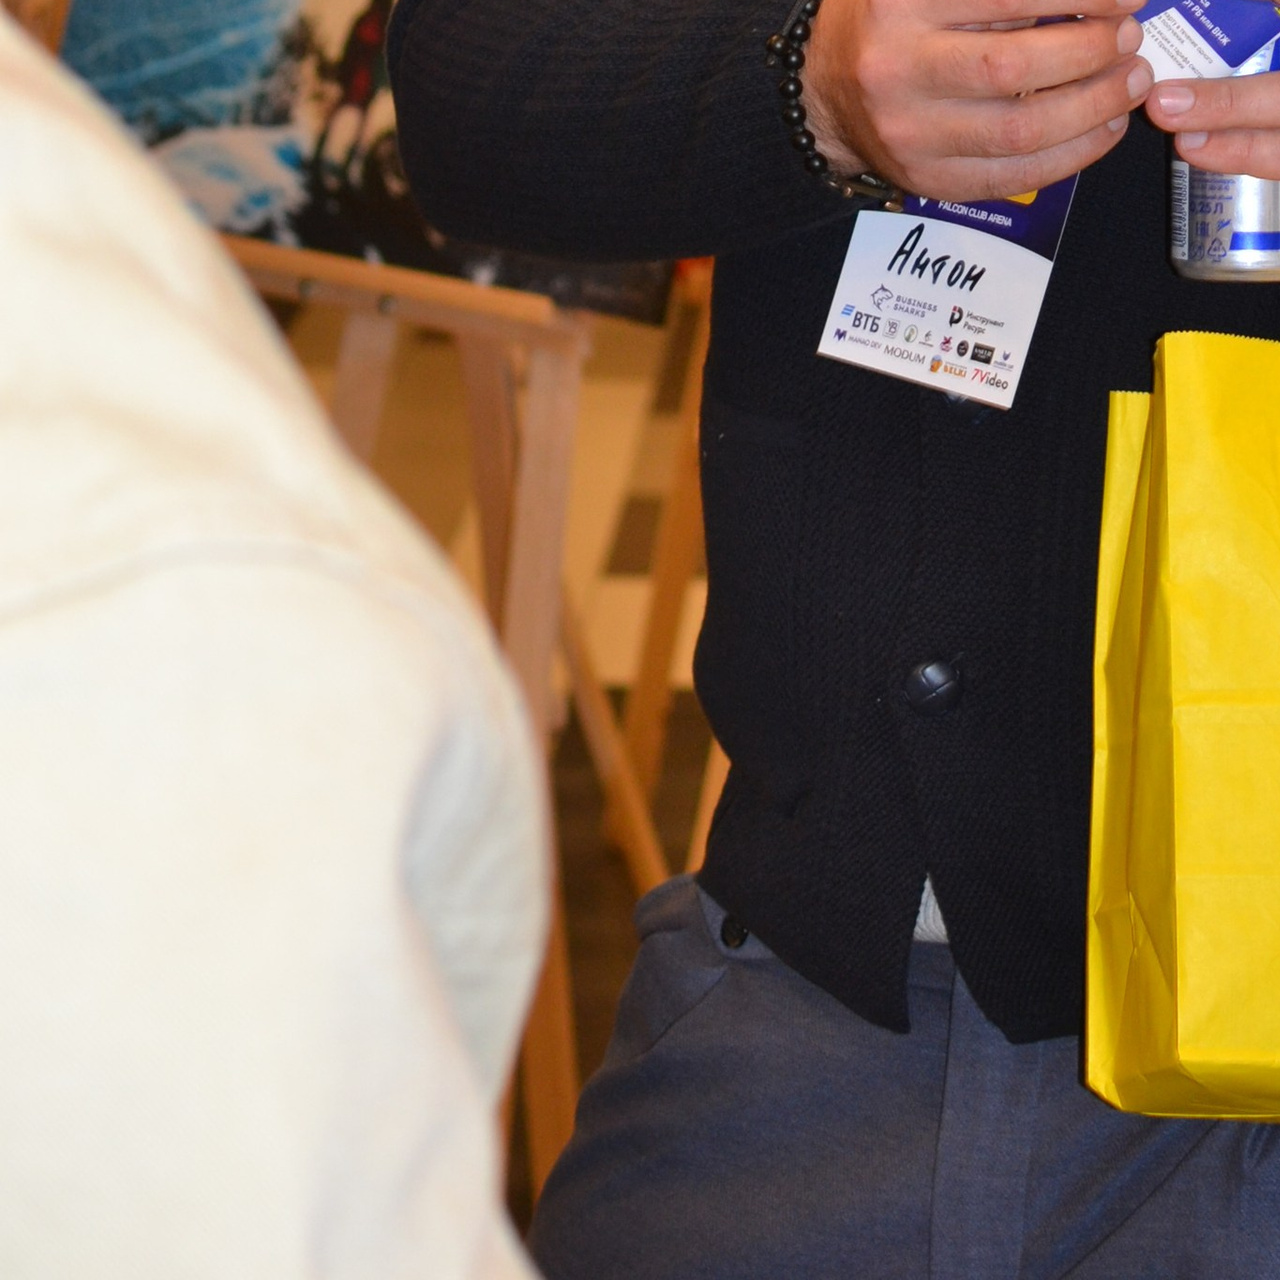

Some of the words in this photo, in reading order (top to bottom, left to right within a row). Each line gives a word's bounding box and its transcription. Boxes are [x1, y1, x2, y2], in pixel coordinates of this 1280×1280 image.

[1200, 15, 1215, 30] или
[1211, 26, 1231, 47] ВНЖ
[938, 200, 968, 215] FALCON
[967, 208, 988, 220] CLUB
[987, 213, 1013, 227] ARENA
[887, 222, 986, 292] Антон
[893, 303, 926, 318] SHARKS
[896, 295, 938, 312] BUSINESS
[852, 311, 881, 333] ВТБ
[963, 321, 986, 335] Ресурс
[966, 310, 1005, 328] Инструмент
[883, 344, 926, 365] MODUM
[971, 367, 1009, 390] 7Video
